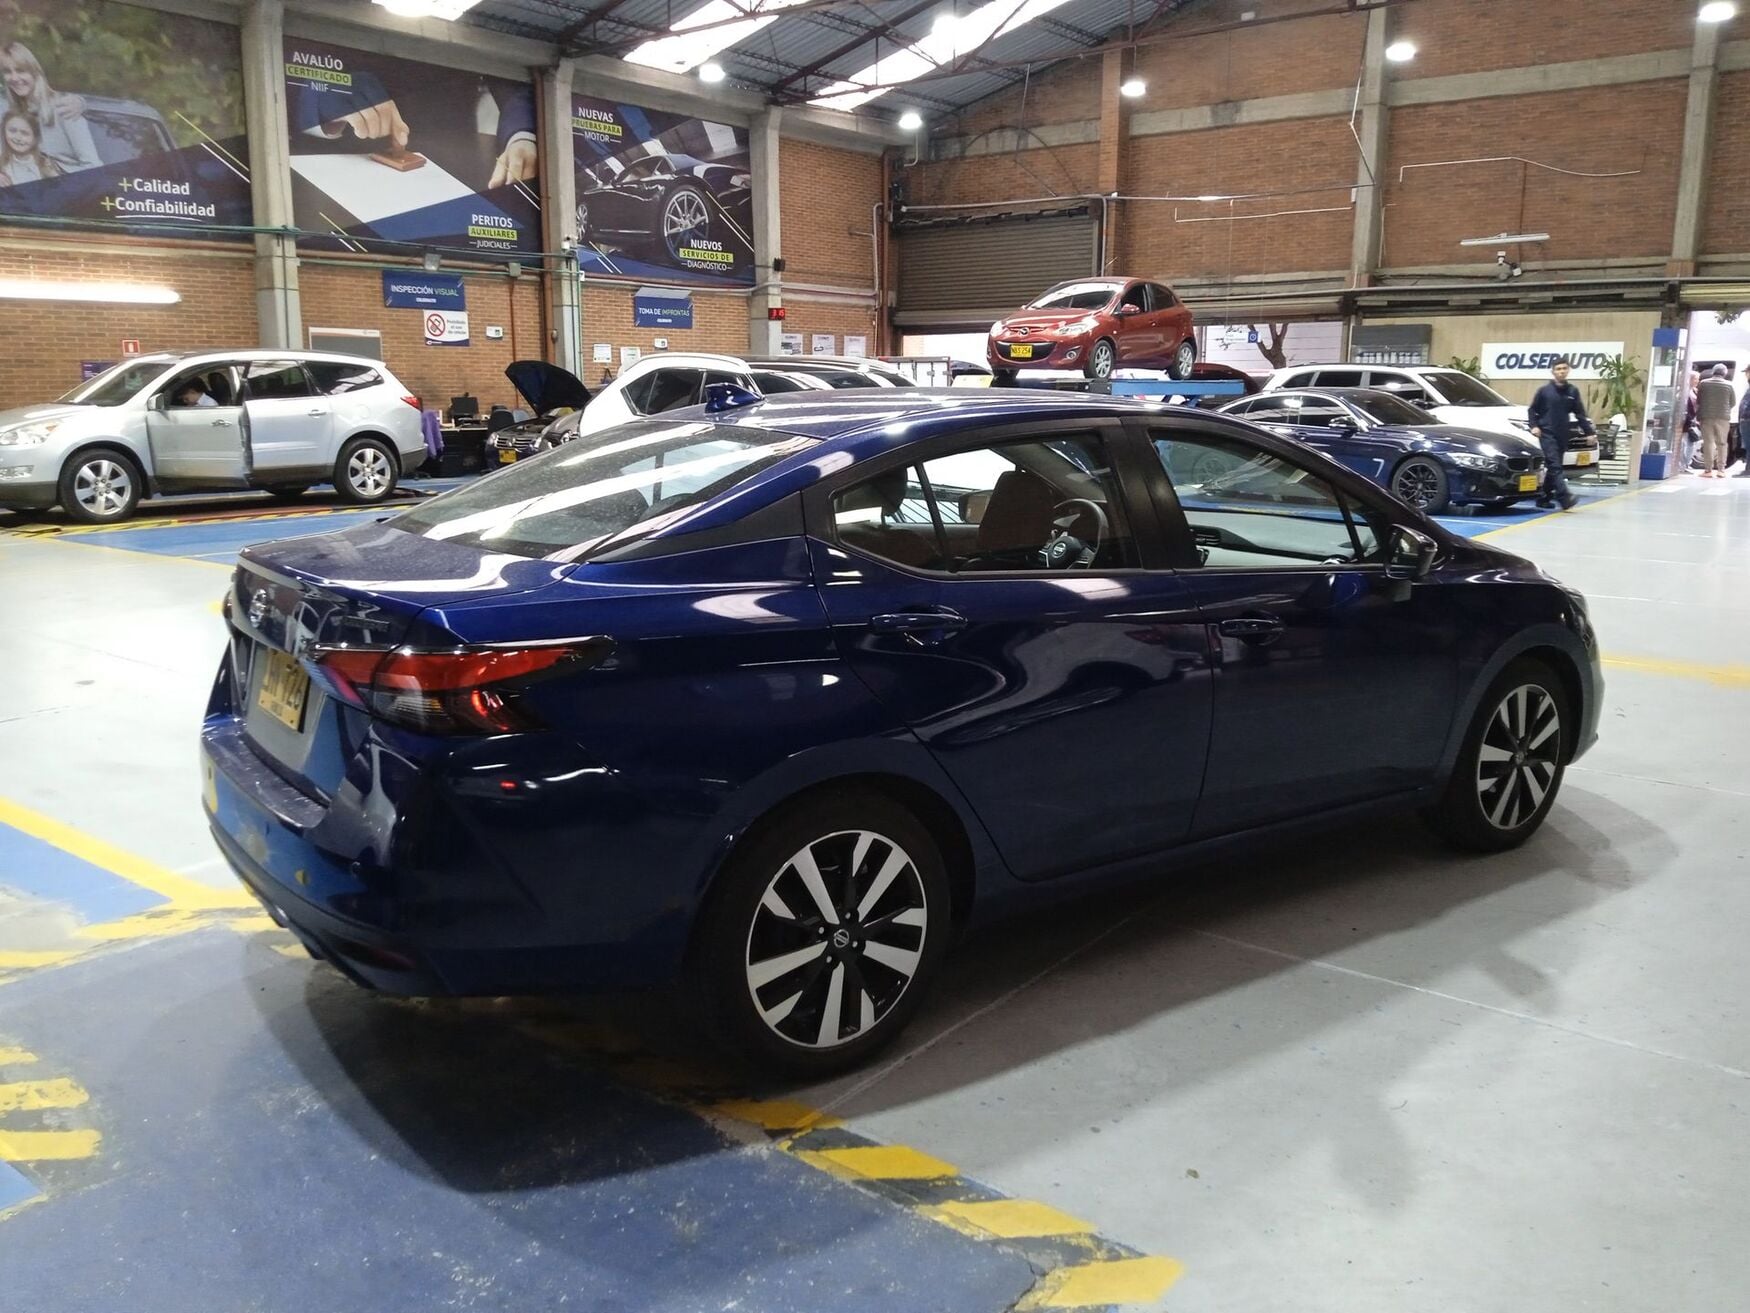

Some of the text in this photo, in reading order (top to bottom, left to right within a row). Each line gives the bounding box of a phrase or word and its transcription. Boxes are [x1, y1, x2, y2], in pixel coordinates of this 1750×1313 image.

[292, 51, 343, 70] AVALÚO
[287, 66, 350, 84] CERTIFICADO
[578, 107, 614, 123] NUEVAS
[602, 124, 621, 134] PARA
[584, 131, 610, 143] MOTOR
[471, 213, 513, 228] PERITOS
[470, 227, 516, 239] AUXILIARES
[476, 239, 511, 250] JUDICIALES
[690, 238, 723, 251] NUEVOS
[682, 249, 731, 262] SERVICIOS DE
[390, 284, 459, 297] INSPECCIÓN VISUAL
[639, 307, 654, 316] TOMA
[654, 308, 661, 316] DE
